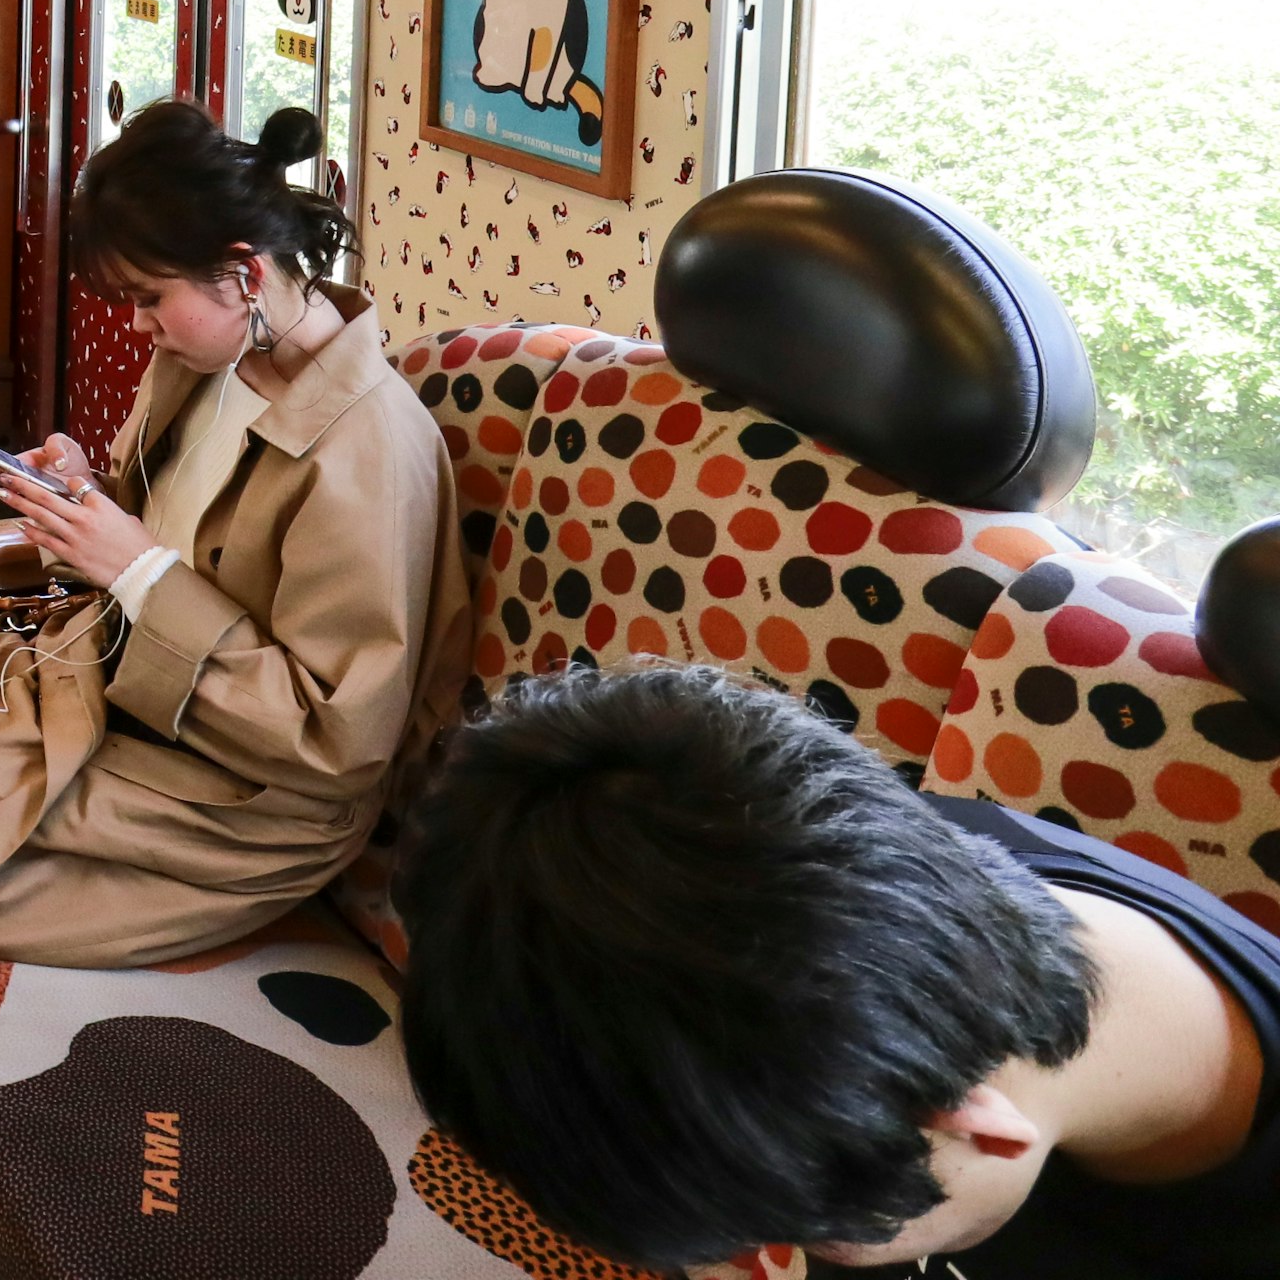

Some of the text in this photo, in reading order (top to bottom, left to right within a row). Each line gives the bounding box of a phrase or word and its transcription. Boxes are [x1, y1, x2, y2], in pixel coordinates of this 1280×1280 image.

[128, 0, 157, 18] たま電車
[502, 130, 523, 143] SUPER
[523, 135, 552, 152] STATION
[552, 143, 581, 160] MASTER
[644, 197, 664, 209] TAMA
[436, 308, 450, 317] TAMA
[691, 424, 729, 455] TAMA
[746, 483, 763, 498] TA
[591, 519, 608, 529] MA
[758, 576, 772, 603] MA
[863, 585, 878, 607] TA
[989, 688, 1005, 718] MA
[1118, 704, 1137, 730] TA
[1188, 838, 1227, 858] MA
[140, 1111, 181, 1216] TAMA
